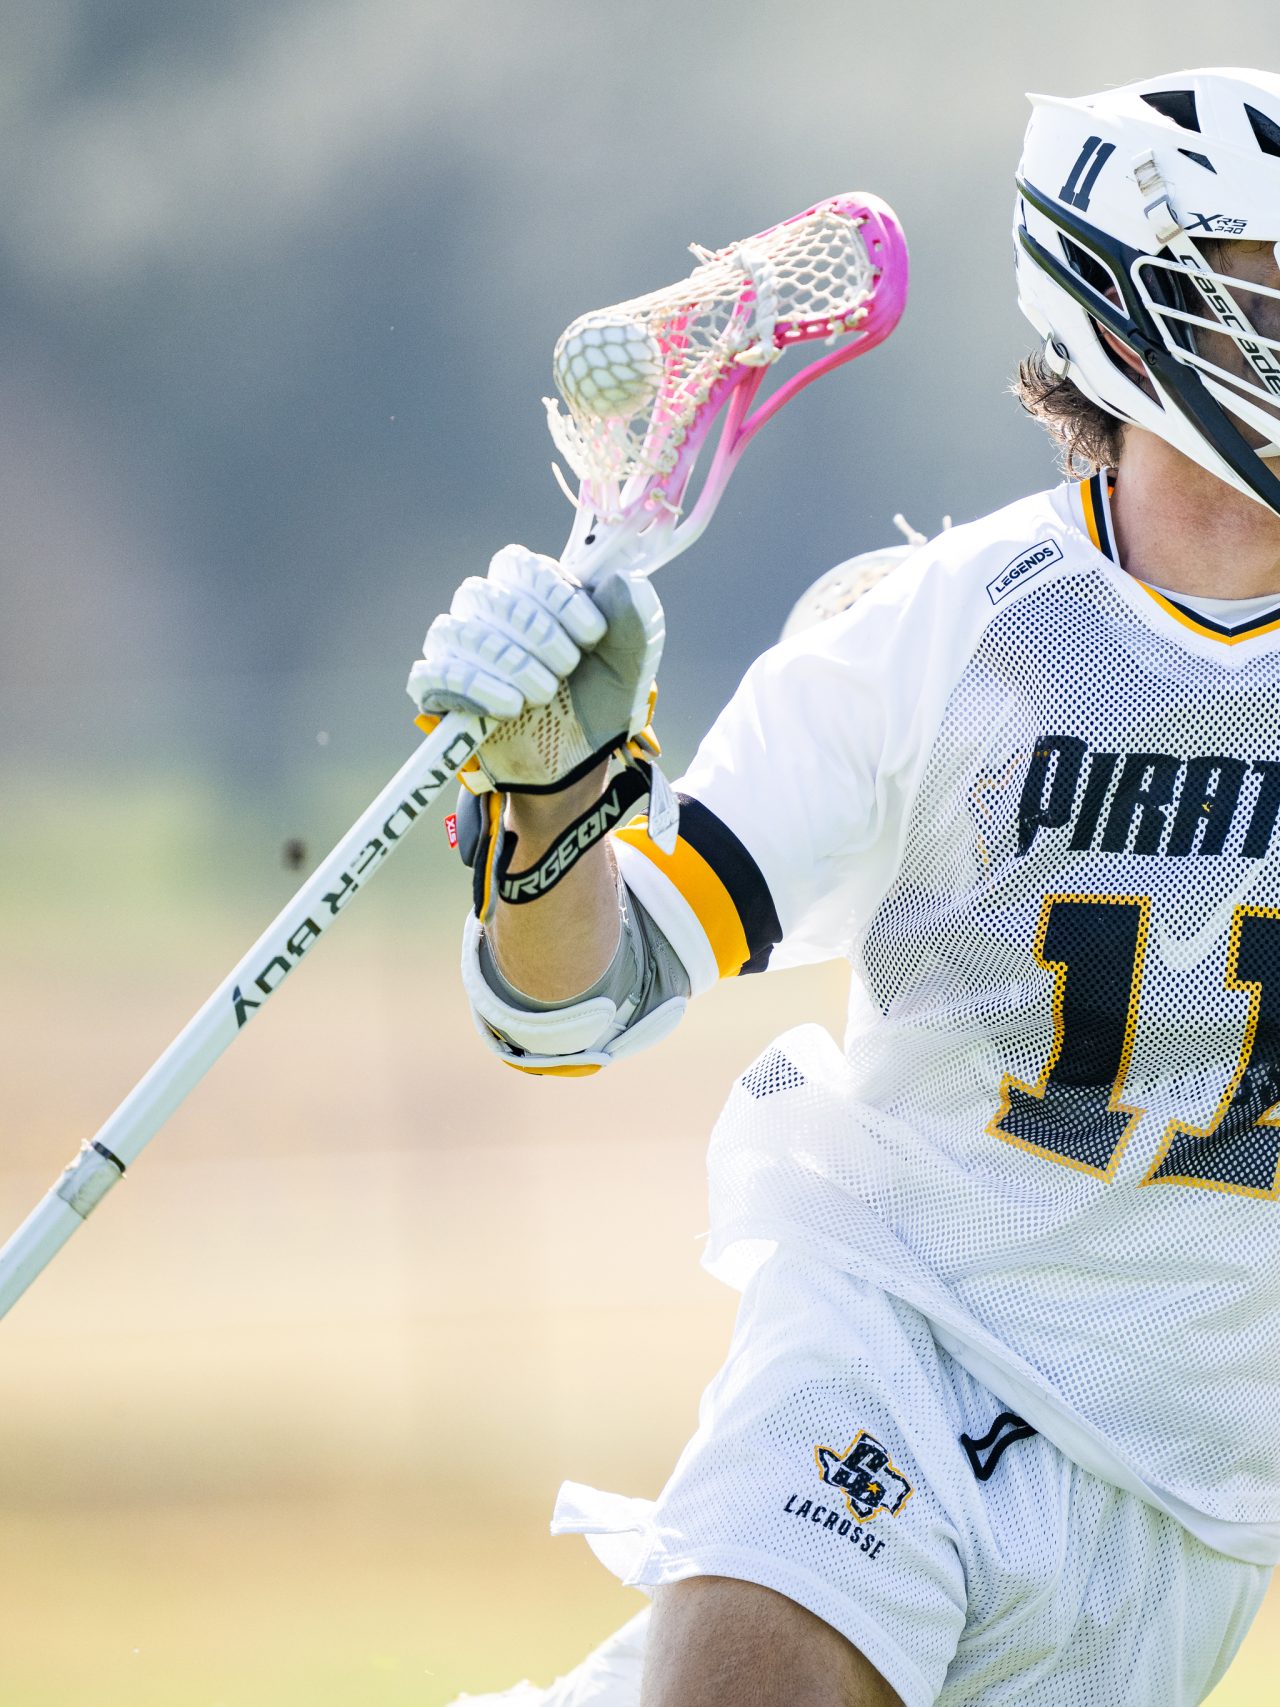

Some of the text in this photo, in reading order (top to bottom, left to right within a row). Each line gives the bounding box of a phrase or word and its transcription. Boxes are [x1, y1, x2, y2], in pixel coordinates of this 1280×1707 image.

[1058, 136, 1117, 213] 11
[995, 547, 1054, 593] LEGENDS
[322, 716, 488, 915] ONDER
[783, 1493, 886, 1561] LACROSSE
